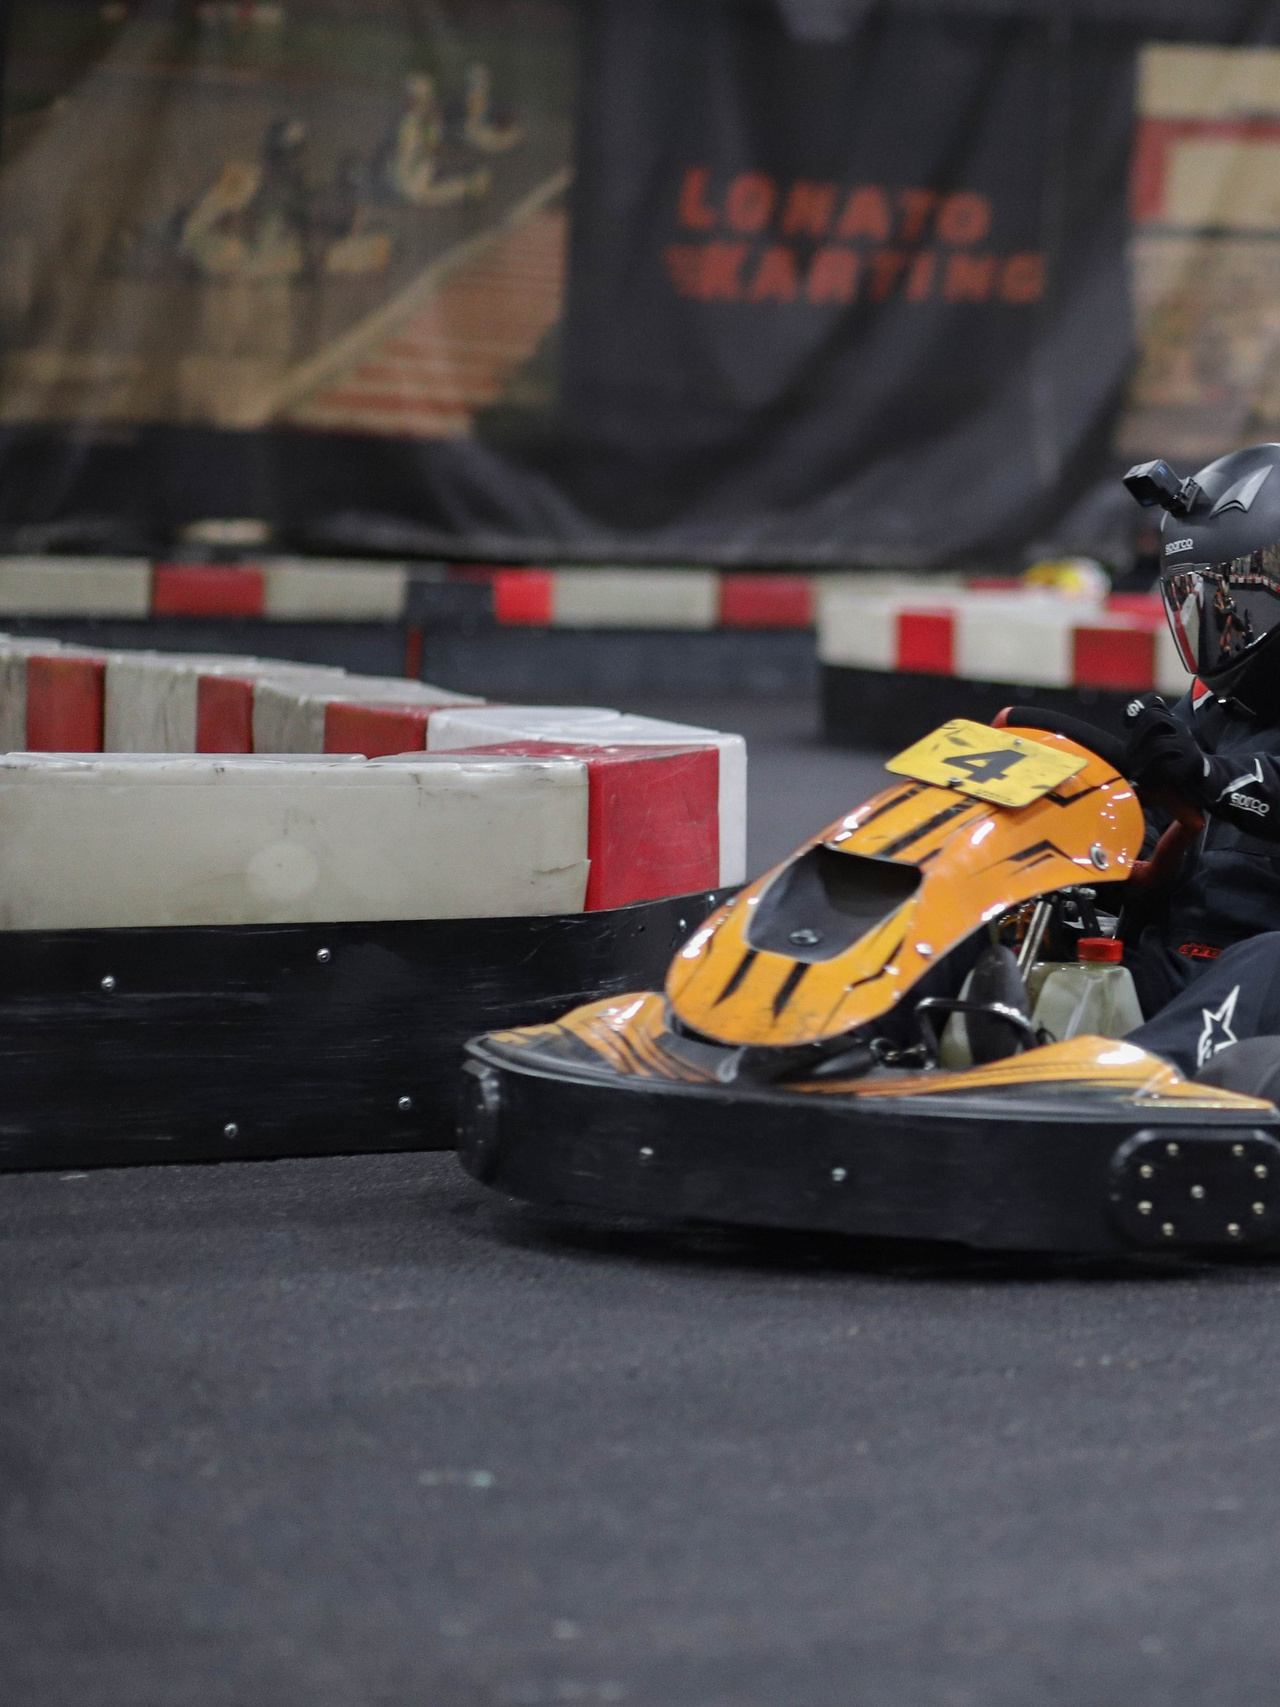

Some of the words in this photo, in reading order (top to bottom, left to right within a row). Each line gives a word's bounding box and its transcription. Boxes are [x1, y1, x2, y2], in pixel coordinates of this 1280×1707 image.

[677, 165, 993, 244] LONATO
[665, 241, 1046, 303] KARTING
[941, 749, 1027, 784] 4
